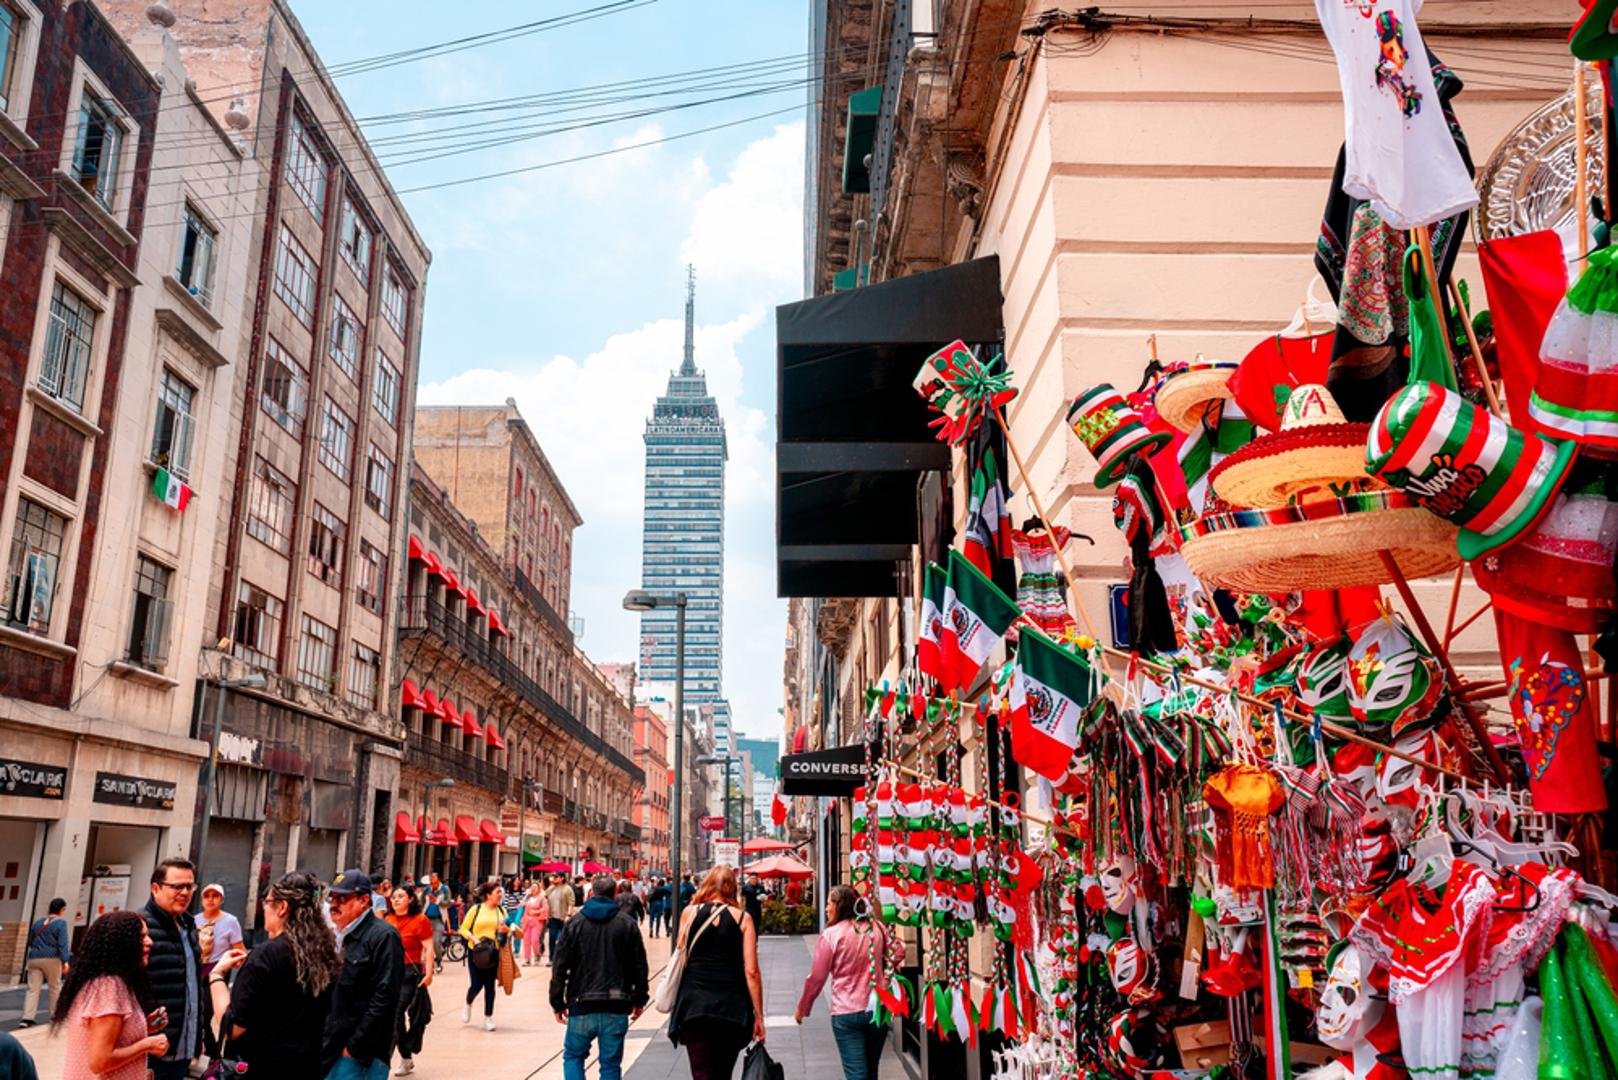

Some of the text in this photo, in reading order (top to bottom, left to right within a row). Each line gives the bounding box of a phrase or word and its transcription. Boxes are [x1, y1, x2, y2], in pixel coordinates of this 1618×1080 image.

[648, 425, 720, 433] LATINOAMERICANA
[790, 761, 869, 775] CONVERSE
[101, 778, 137, 795] SANTA
